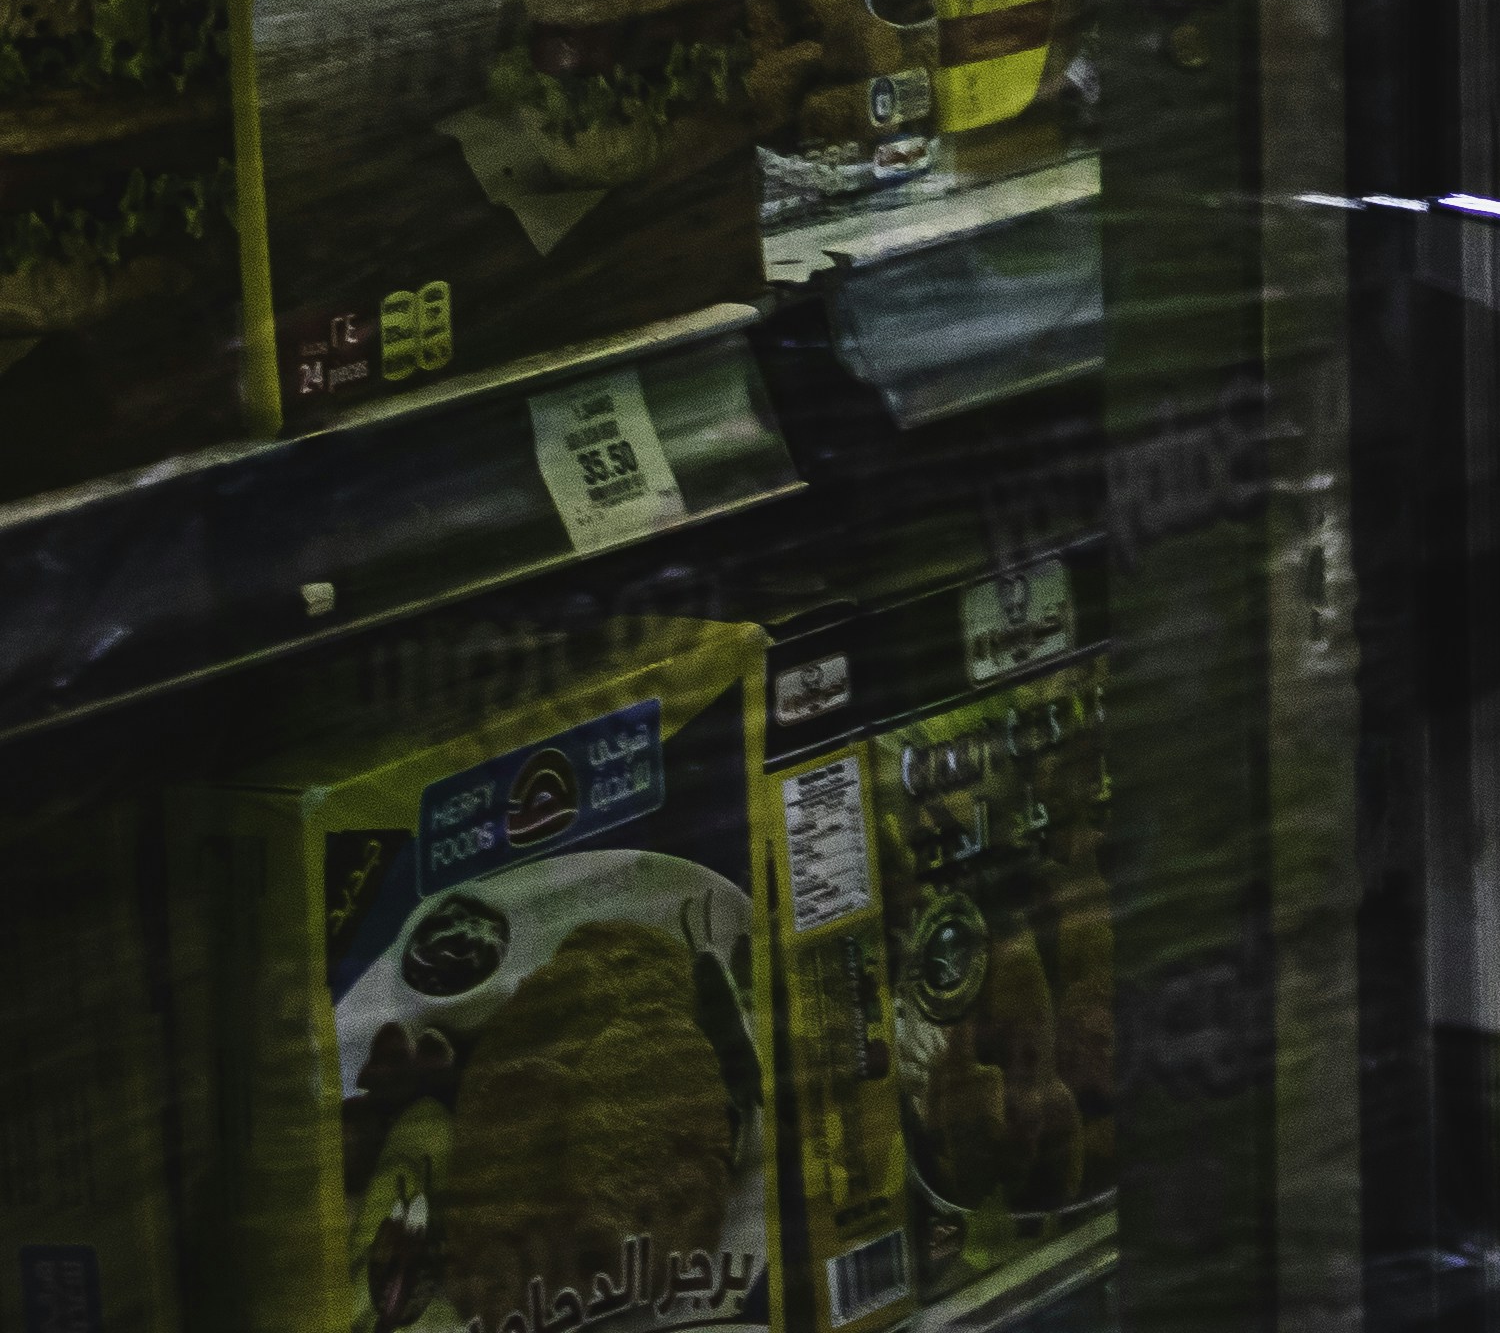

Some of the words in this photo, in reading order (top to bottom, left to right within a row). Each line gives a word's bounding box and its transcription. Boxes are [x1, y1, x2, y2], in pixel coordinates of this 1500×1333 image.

[299, 360, 325, 395] 24
[576, 440, 639, 486] 35.50
[429, 820, 496, 873] FOODS
[655, 1247, 754, 1318] برجر
